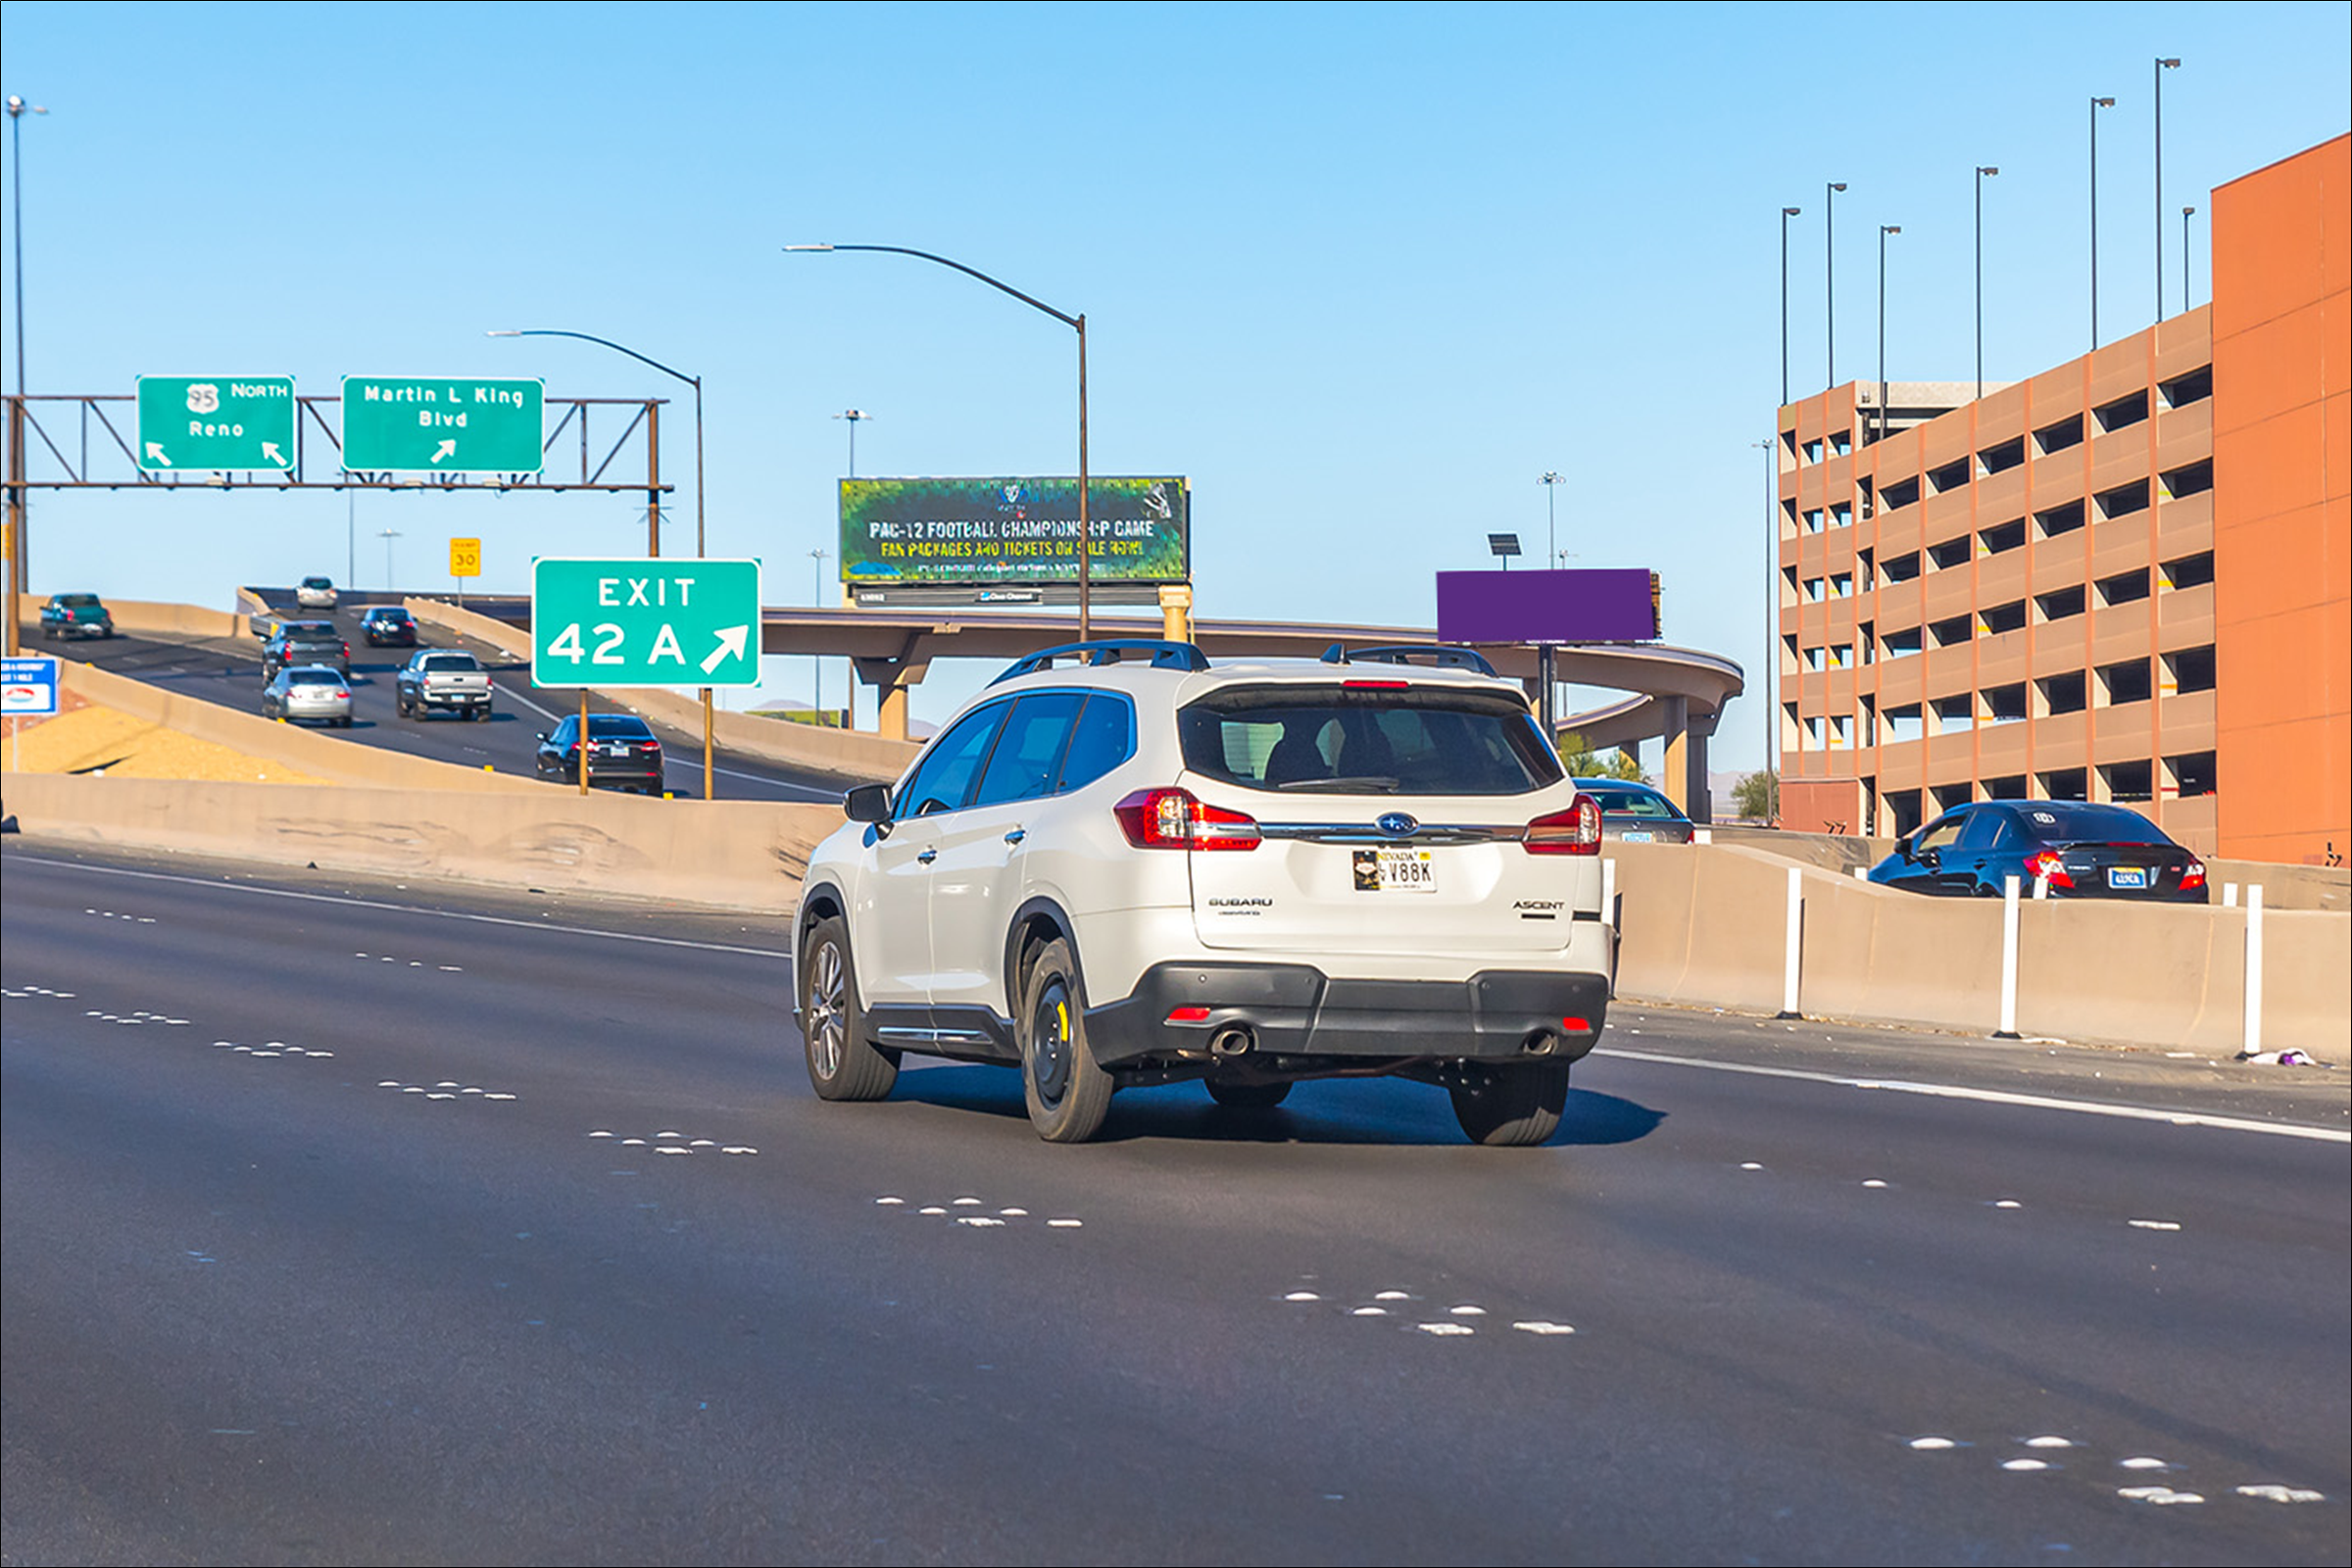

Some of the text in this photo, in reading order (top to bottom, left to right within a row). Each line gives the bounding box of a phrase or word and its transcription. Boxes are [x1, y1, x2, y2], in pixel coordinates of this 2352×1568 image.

[189, 390, 215, 407] 95
[231, 383, 287, 397] NORTH
[365, 385, 523, 409] Martin L King
[418, 410, 467, 427] Blvd
[189, 420, 243, 437] Reno
[869, 521, 924, 538] PAC-12
[927, 520, 998, 538] FOOTBALL
[1114, 519, 1154, 537] GAME
[881, 542, 906, 557] FAN
[907, 541, 972, 557] PACKAGES
[974, 541, 1000, 557] AND
[1004, 541, 1054, 557] TICKETS
[456, 554, 475, 565] 30
[599, 578, 695, 606] EXIT
[547, 622, 686, 664] 42 A
[1377, 852, 1414, 861] NEVADA
[1208, 898, 1273, 906] SUBARU
[1512, 901, 1565, 909] ASCENT
